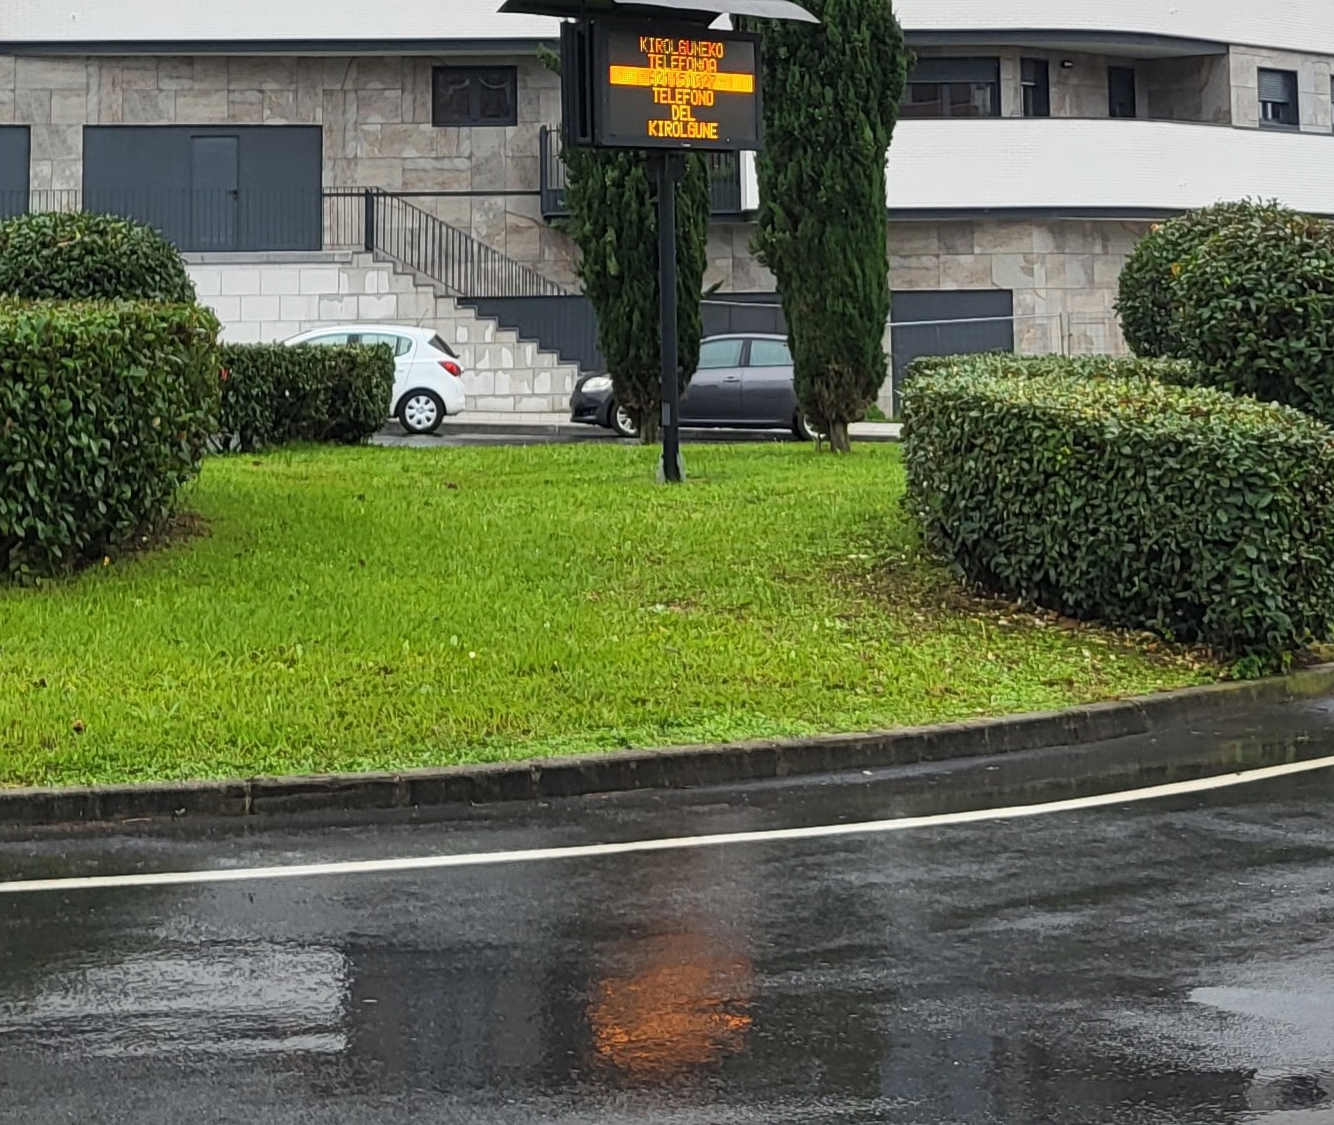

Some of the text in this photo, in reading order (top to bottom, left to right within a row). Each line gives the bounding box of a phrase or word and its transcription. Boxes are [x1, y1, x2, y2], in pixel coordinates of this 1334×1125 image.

[639, 36, 724, 58] KIROLGUNEKO
[652, 87, 714, 106] TELEFONO
[671, 105, 697, 121] DEL
[648, 120, 719, 139] KIROLGUNE
